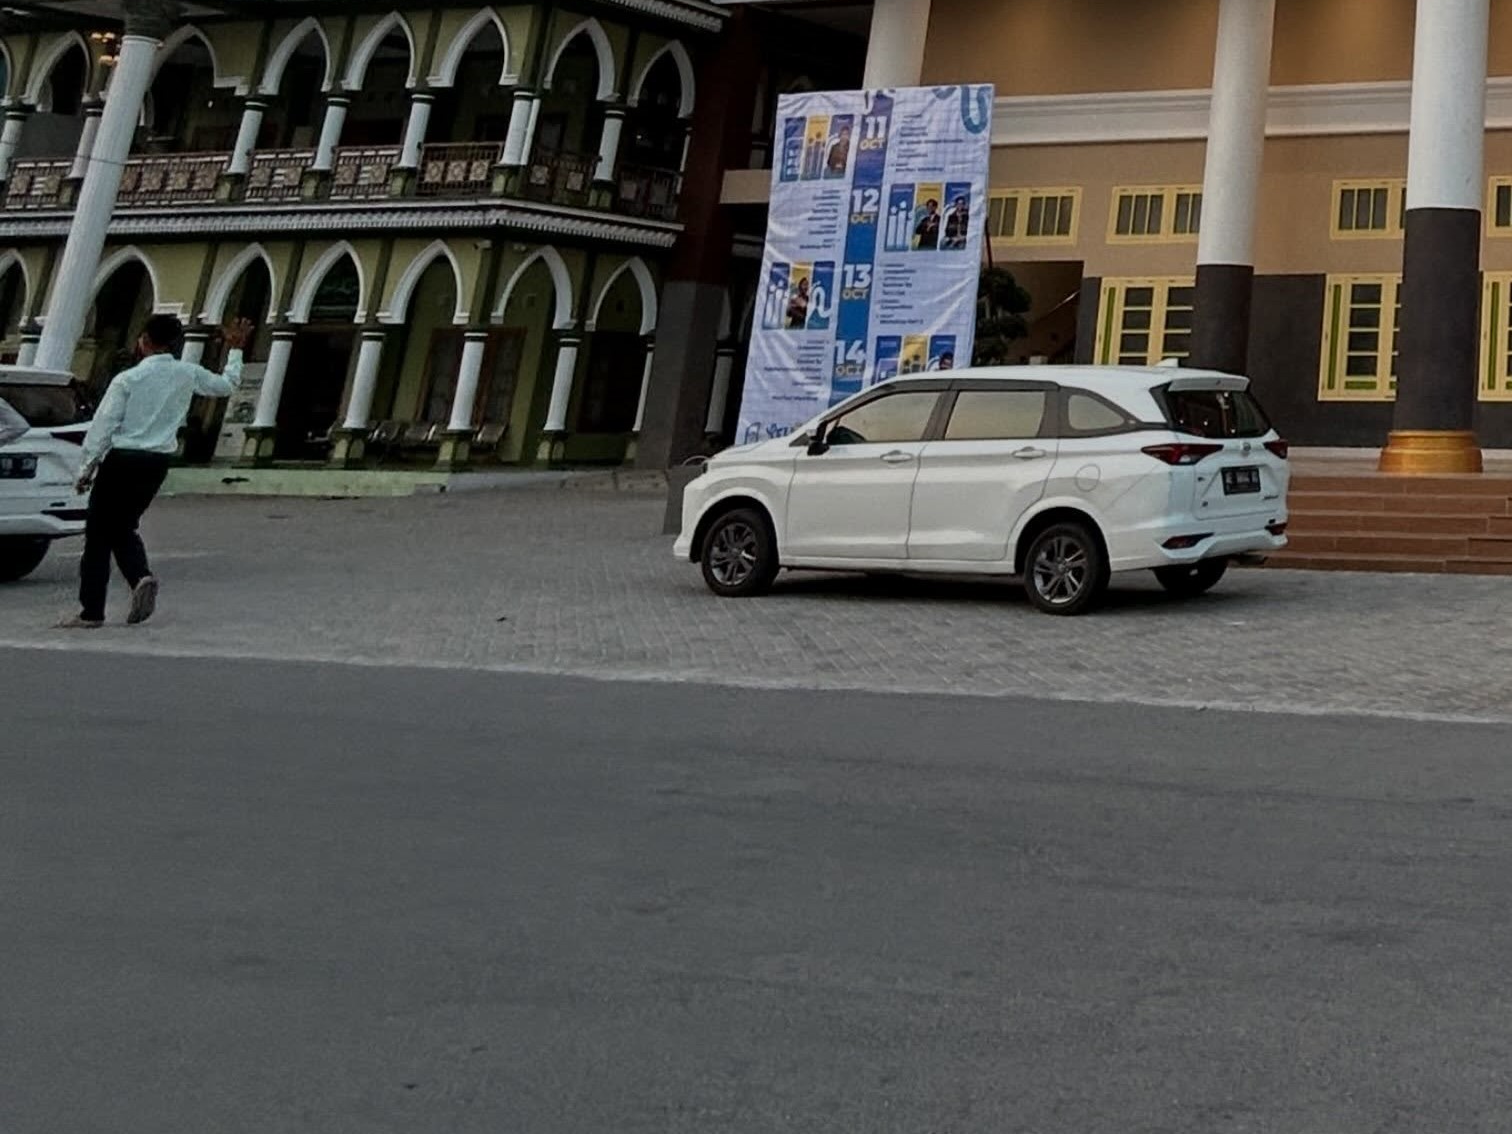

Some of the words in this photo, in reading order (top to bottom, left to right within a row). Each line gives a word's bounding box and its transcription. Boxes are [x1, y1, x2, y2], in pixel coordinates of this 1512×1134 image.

[865, 116, 888, 139] 11
[852, 188, 880, 213] 12
[843, 264, 872, 288] 13
[835, 339, 867, 364] 14
